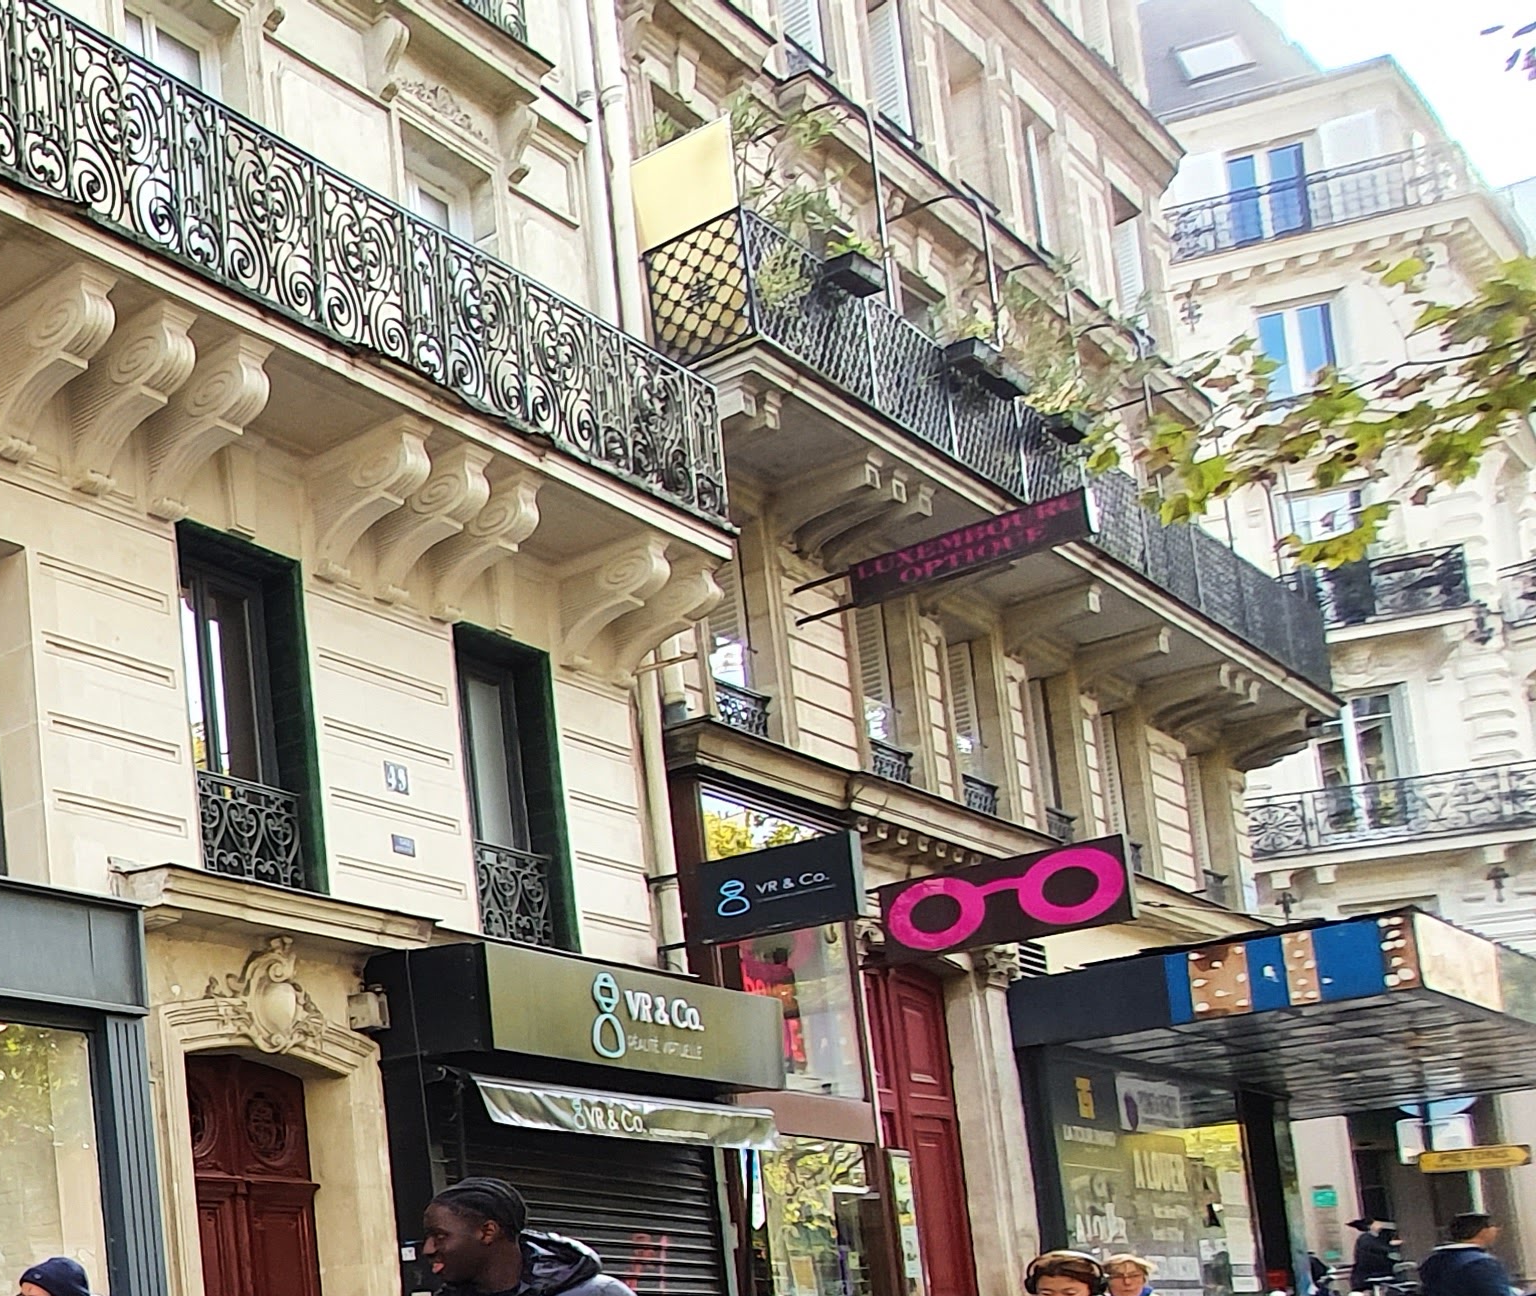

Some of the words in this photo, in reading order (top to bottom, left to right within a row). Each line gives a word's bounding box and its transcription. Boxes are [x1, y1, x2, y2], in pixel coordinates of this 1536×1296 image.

[900, 525, 1044, 582] OPTIQUE
[755, 880, 778, 894] VR
[783, 877, 795, 889] &
[624, 989, 653, 1024] VR
[654, 996, 670, 1026] &
[671, 998, 705, 1032] Co.
[584, 1104, 607, 1130] VR
[607, 1102, 619, 1131] &
[620, 1109, 649, 1133] Co.
